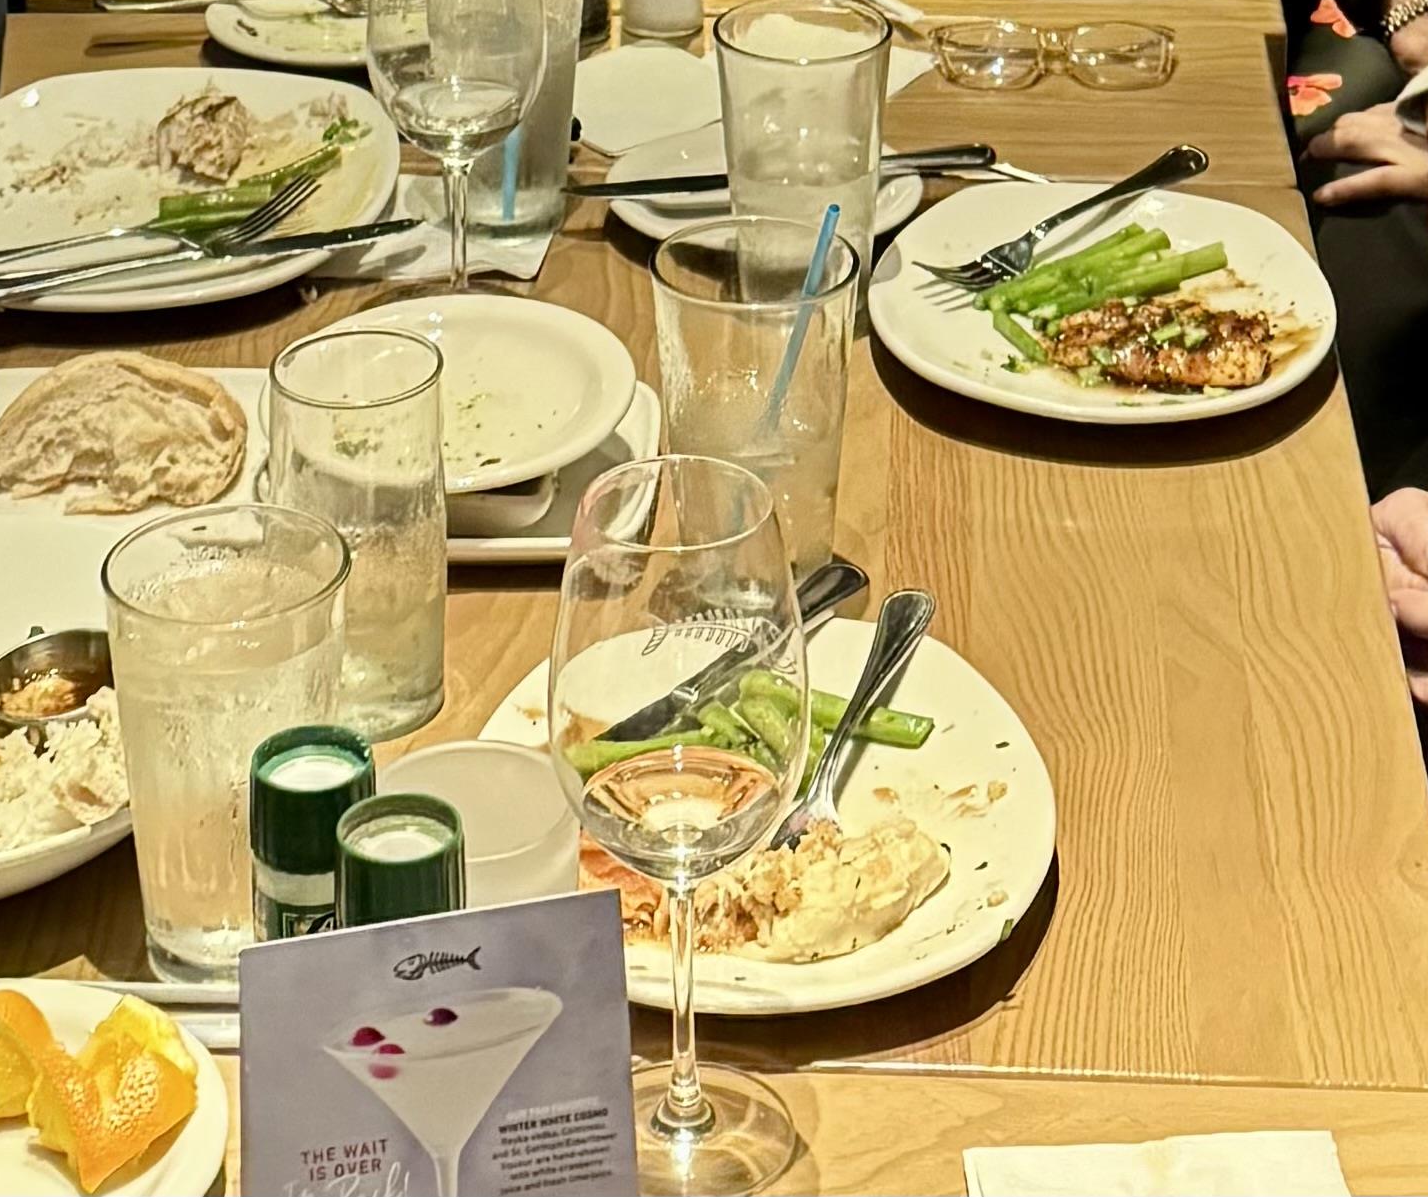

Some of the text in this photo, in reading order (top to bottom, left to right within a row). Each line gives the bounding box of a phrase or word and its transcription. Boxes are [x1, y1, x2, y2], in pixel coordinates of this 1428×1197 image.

[498, 1108, 608, 1134] WINTER WHITE COSMO
[300, 1139, 388, 1165] THE WAIT
[310, 1166, 326, 1181] IS
[334, 1158, 382, 1177] OVER
